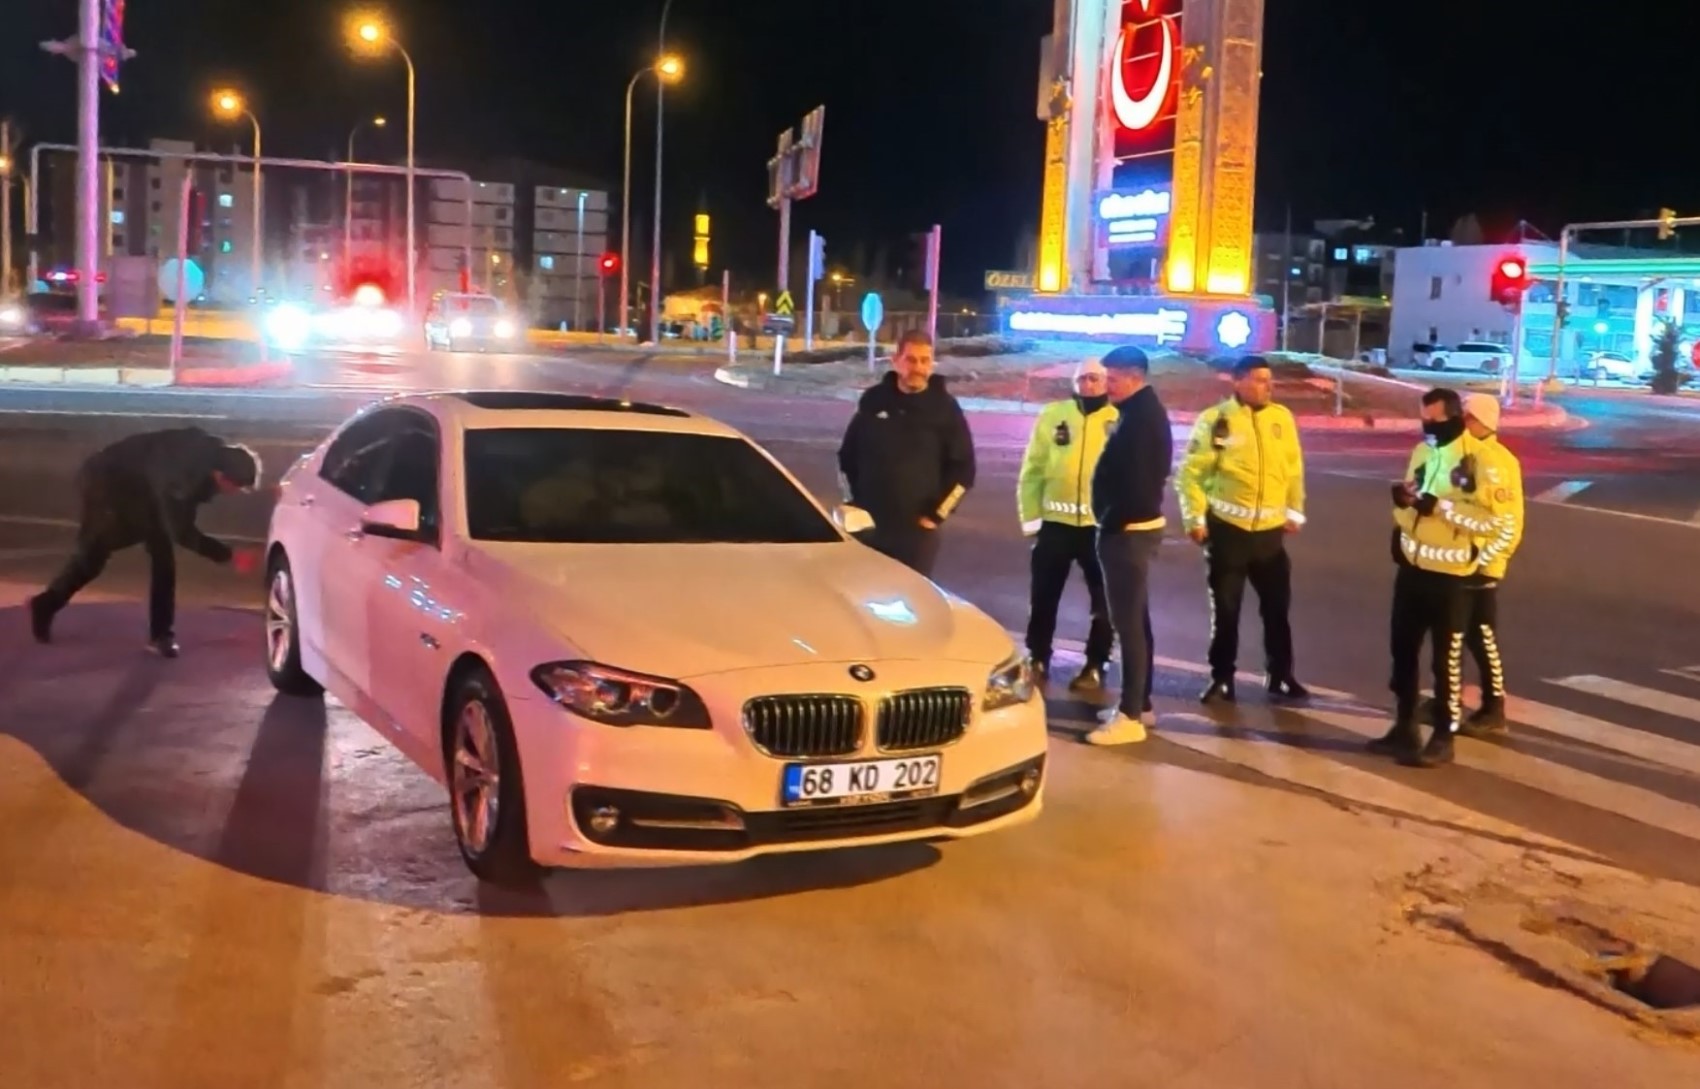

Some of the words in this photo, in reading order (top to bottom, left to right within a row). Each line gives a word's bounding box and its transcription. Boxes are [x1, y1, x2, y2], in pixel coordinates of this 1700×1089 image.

[802, 768, 833, 796] 68
[848, 764, 880, 792] KD
[893, 760, 937, 789] 202
